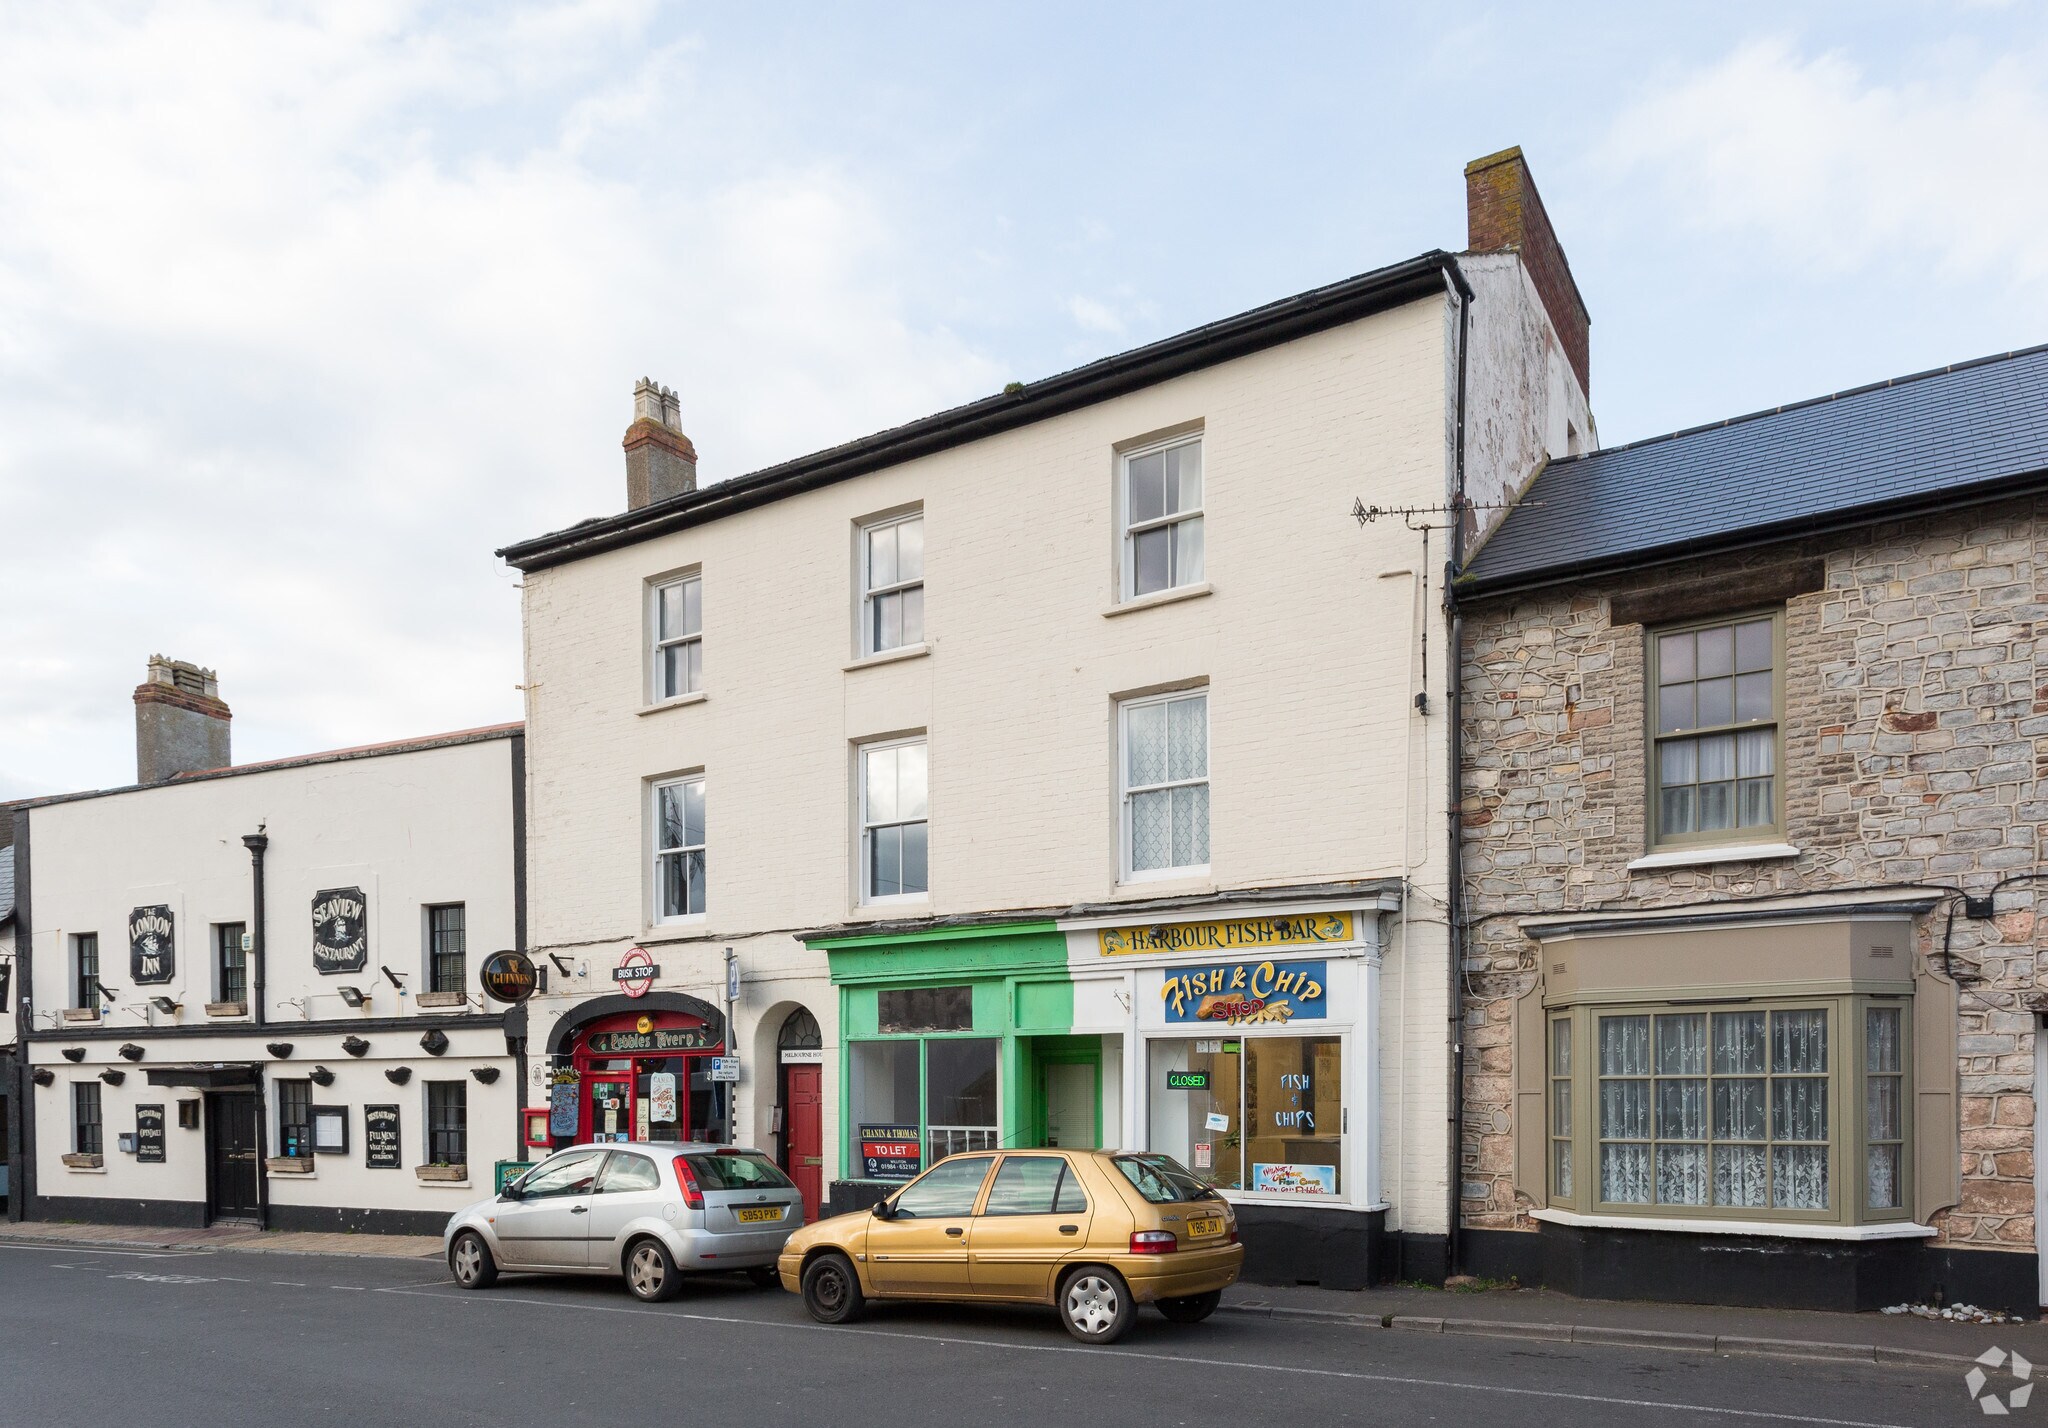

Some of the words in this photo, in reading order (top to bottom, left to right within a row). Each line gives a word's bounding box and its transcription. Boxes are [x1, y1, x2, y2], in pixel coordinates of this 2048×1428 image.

[313, 899, 363, 927] SEAVIEW
[130, 916, 172, 943] LONDON
[1126, 924, 1225, 951] HARBOUR
[1226, 921, 1273, 945] FISH
[1279, 918, 1329, 942] BAR
[314, 937, 364, 961] RESTAURANT
[141, 956, 161, 976] INN
[618, 969, 633, 979] BUSK
[635, 967, 653, 977] STOP
[493, 973, 532, 985] GUINNESS
[1161, 968, 1225, 1018] FISH
[1230, 965, 1246, 989] &
[1251, 961, 1322, 1001] CHIP
[1212, 998, 1265, 1019] SHOP
[611, 1033, 650, 1051] Pebbles
[655, 1031, 694, 1049] Tavern
[1169, 1075, 1206, 1086] CLOSED
[1281, 1074, 1310, 1090] FISH
[1275, 1110, 1315, 1129] CHIPS
[862, 1129, 885, 1138] CHANIN
[887, 1130, 892, 1138] &
[893, 1129, 918, 1138] THOMAS
[875, 1146, 888, 1155] TO
[889, 1146, 907, 1155] LET
[742, 1210, 763, 1221] SB53
[764, 1208, 778, 1219] PXF
[1191, 1221, 1206, 1235] Y861
